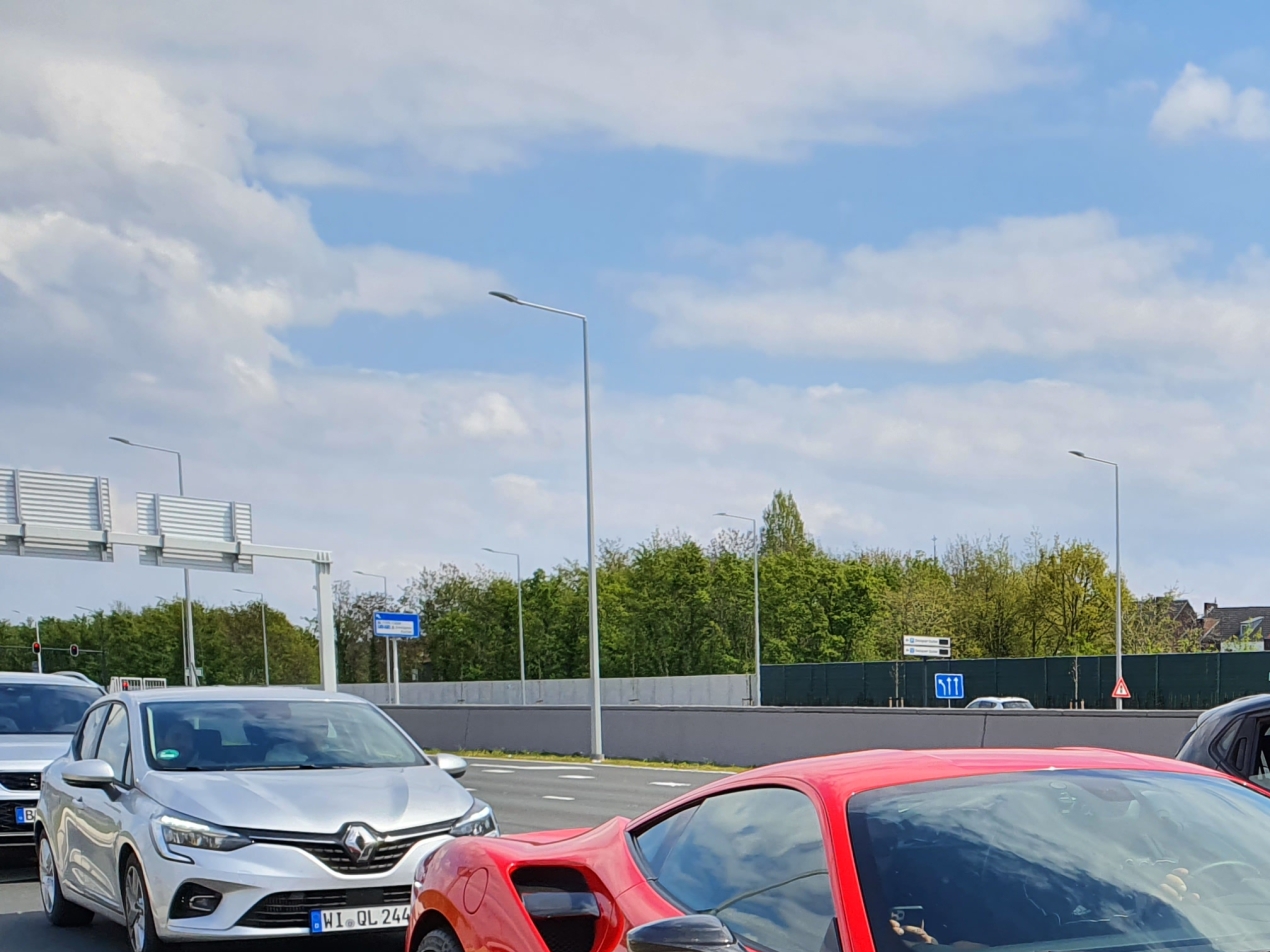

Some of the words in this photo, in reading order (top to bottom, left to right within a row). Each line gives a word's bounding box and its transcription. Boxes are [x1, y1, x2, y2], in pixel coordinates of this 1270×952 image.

[323, 911, 343, 929] WI
[357, 910, 378, 927] QL
[382, 908, 410, 926] 244
